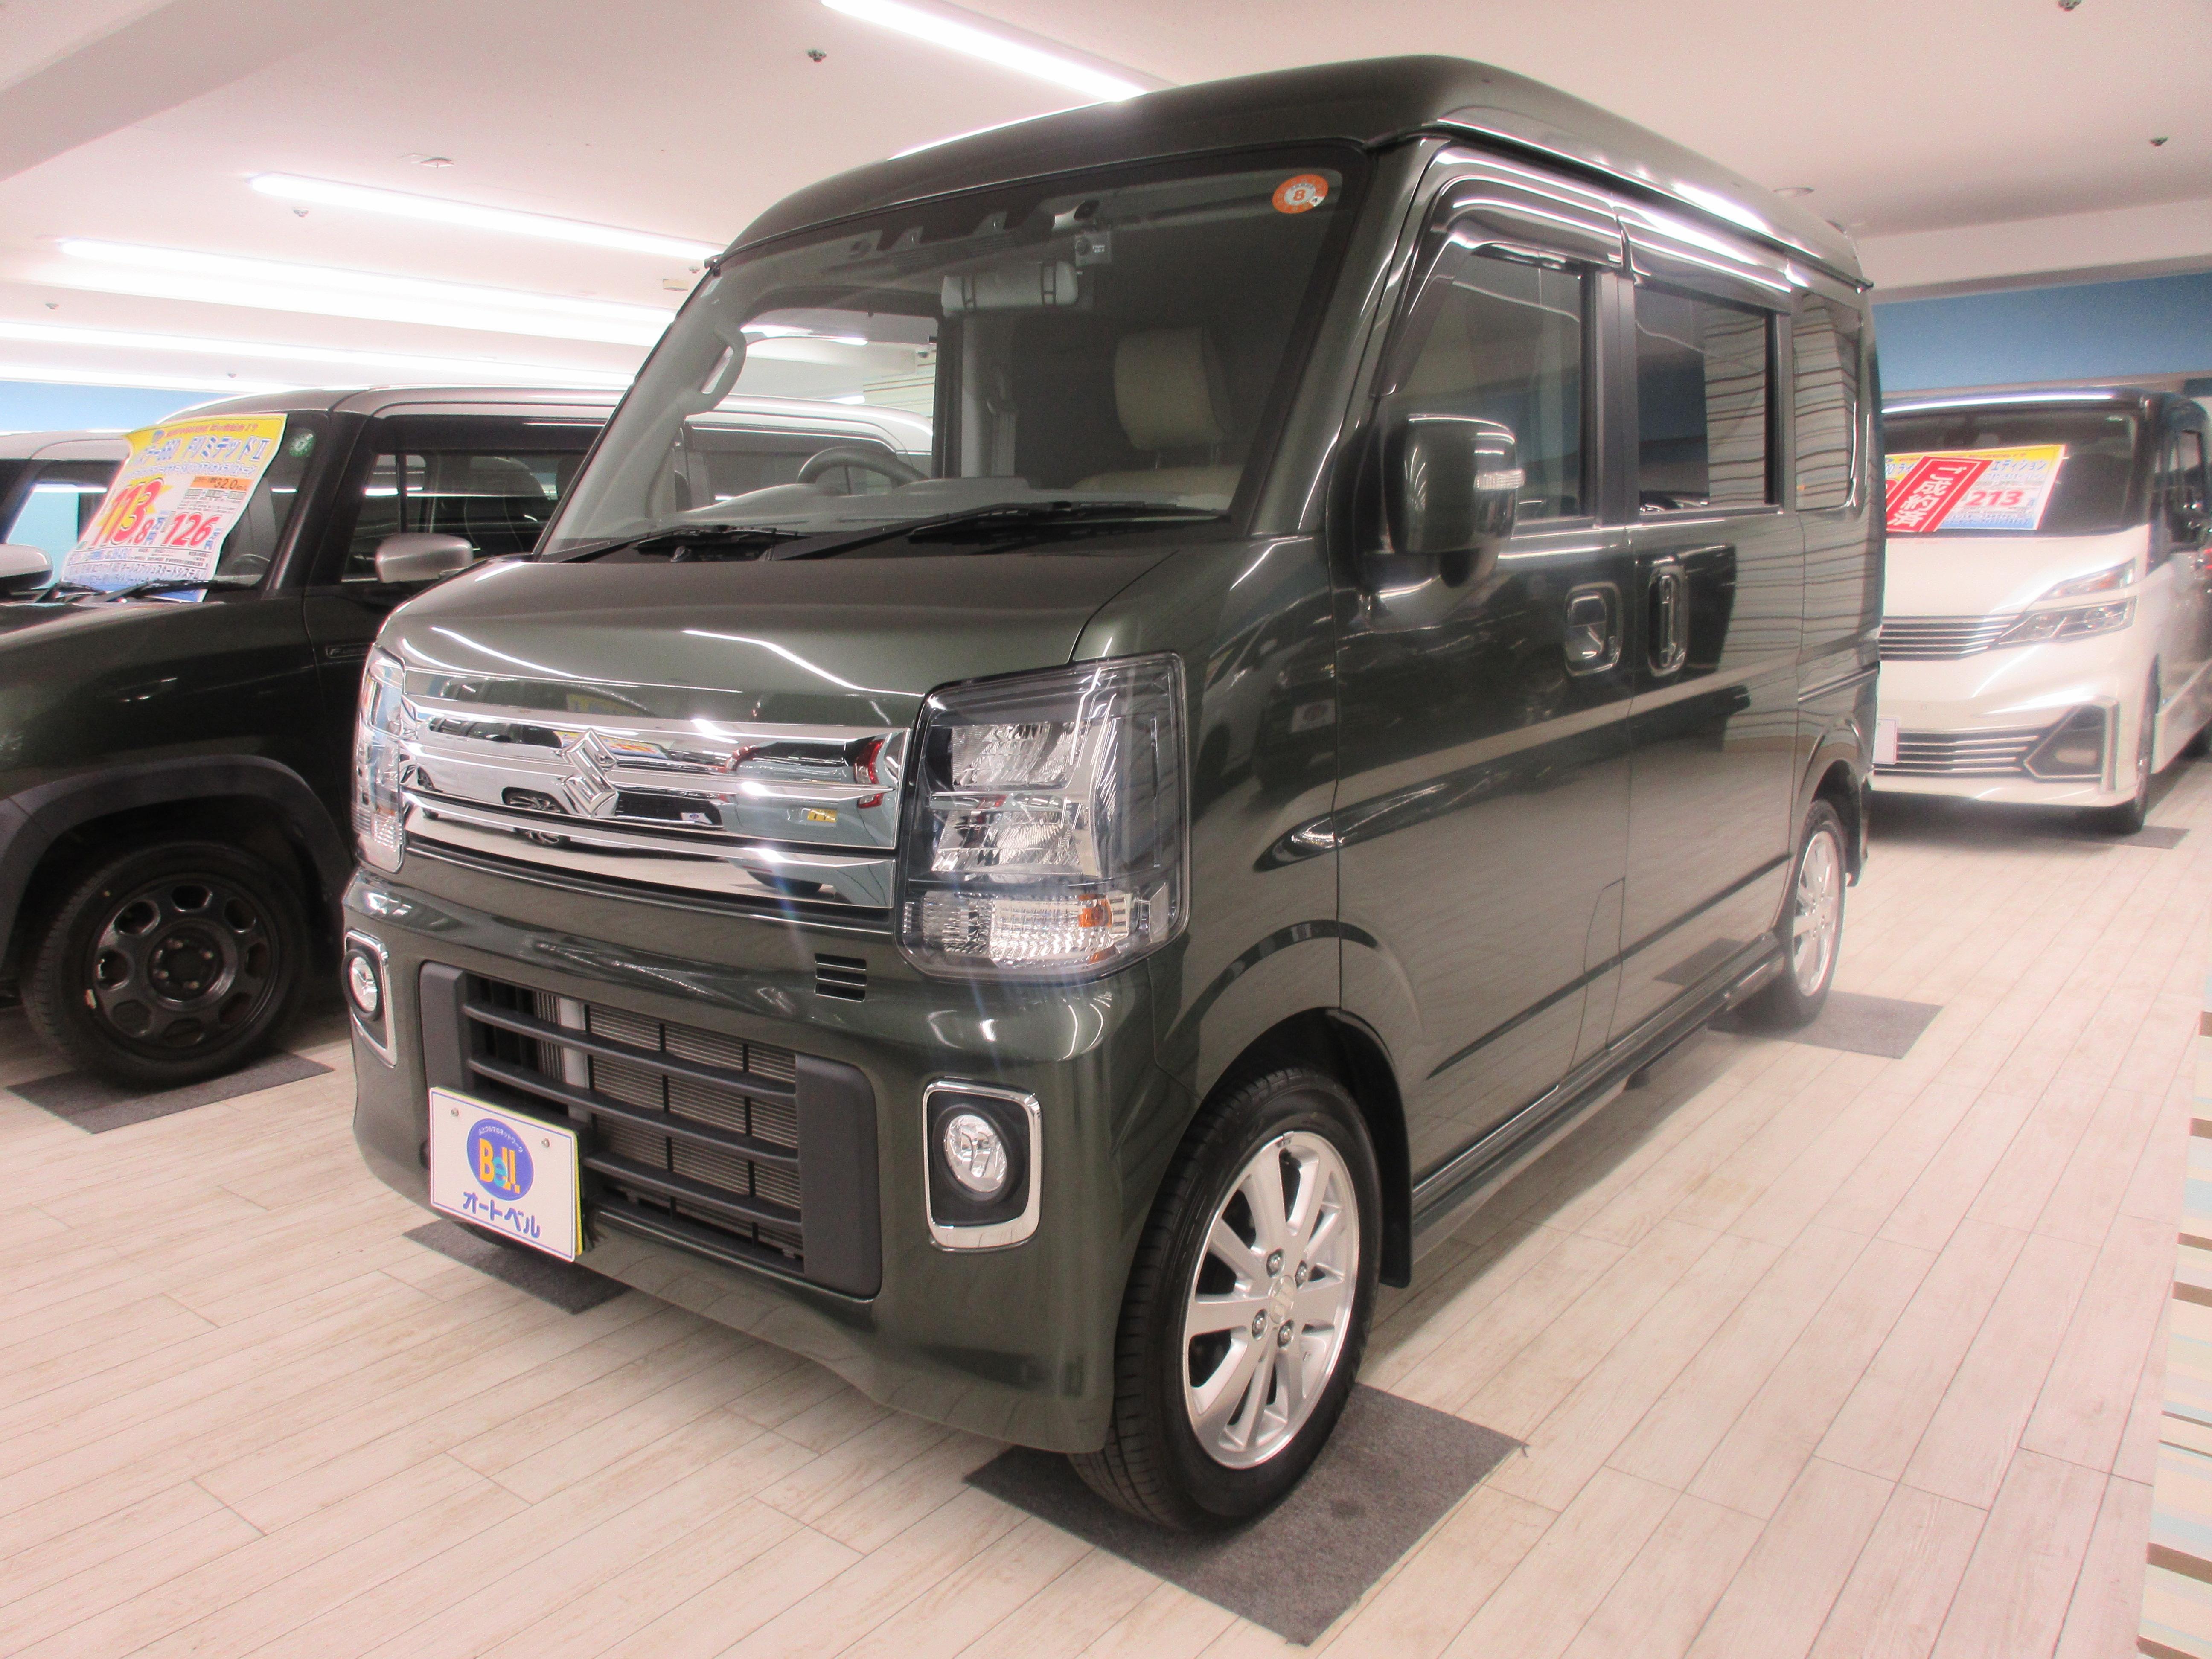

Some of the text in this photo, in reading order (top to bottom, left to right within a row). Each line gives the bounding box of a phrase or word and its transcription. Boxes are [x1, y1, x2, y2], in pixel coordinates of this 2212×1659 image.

[1887, 466, 1967, 527] ご成約済
[1965, 490, 2024, 506] 213
[161, 512, 222, 547] 126
[462, 1191, 541, 1239] オートベル
